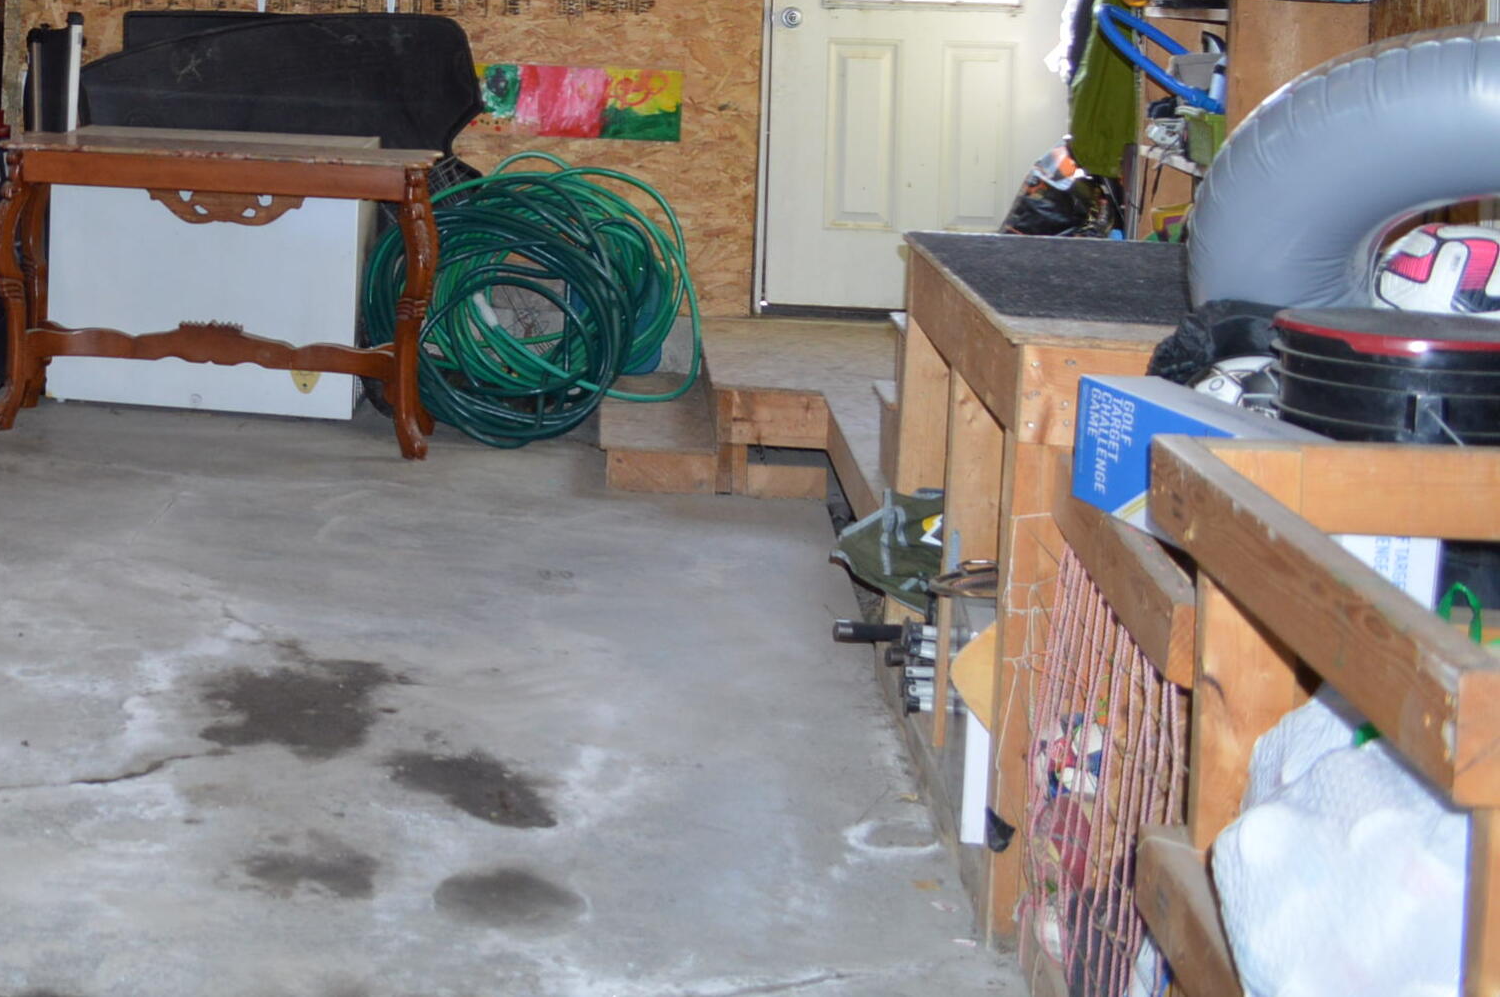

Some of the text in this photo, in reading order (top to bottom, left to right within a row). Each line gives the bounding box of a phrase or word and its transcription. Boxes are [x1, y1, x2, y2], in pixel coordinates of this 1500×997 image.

[1087, 387, 1102, 438] GAME
[1107, 397, 1125, 463] TARGET
[1121, 400, 1135, 448] GOLF
[1094, 392, 1112, 495] CHALLENGE
[1391, 546, 1410, 591] TARGE
